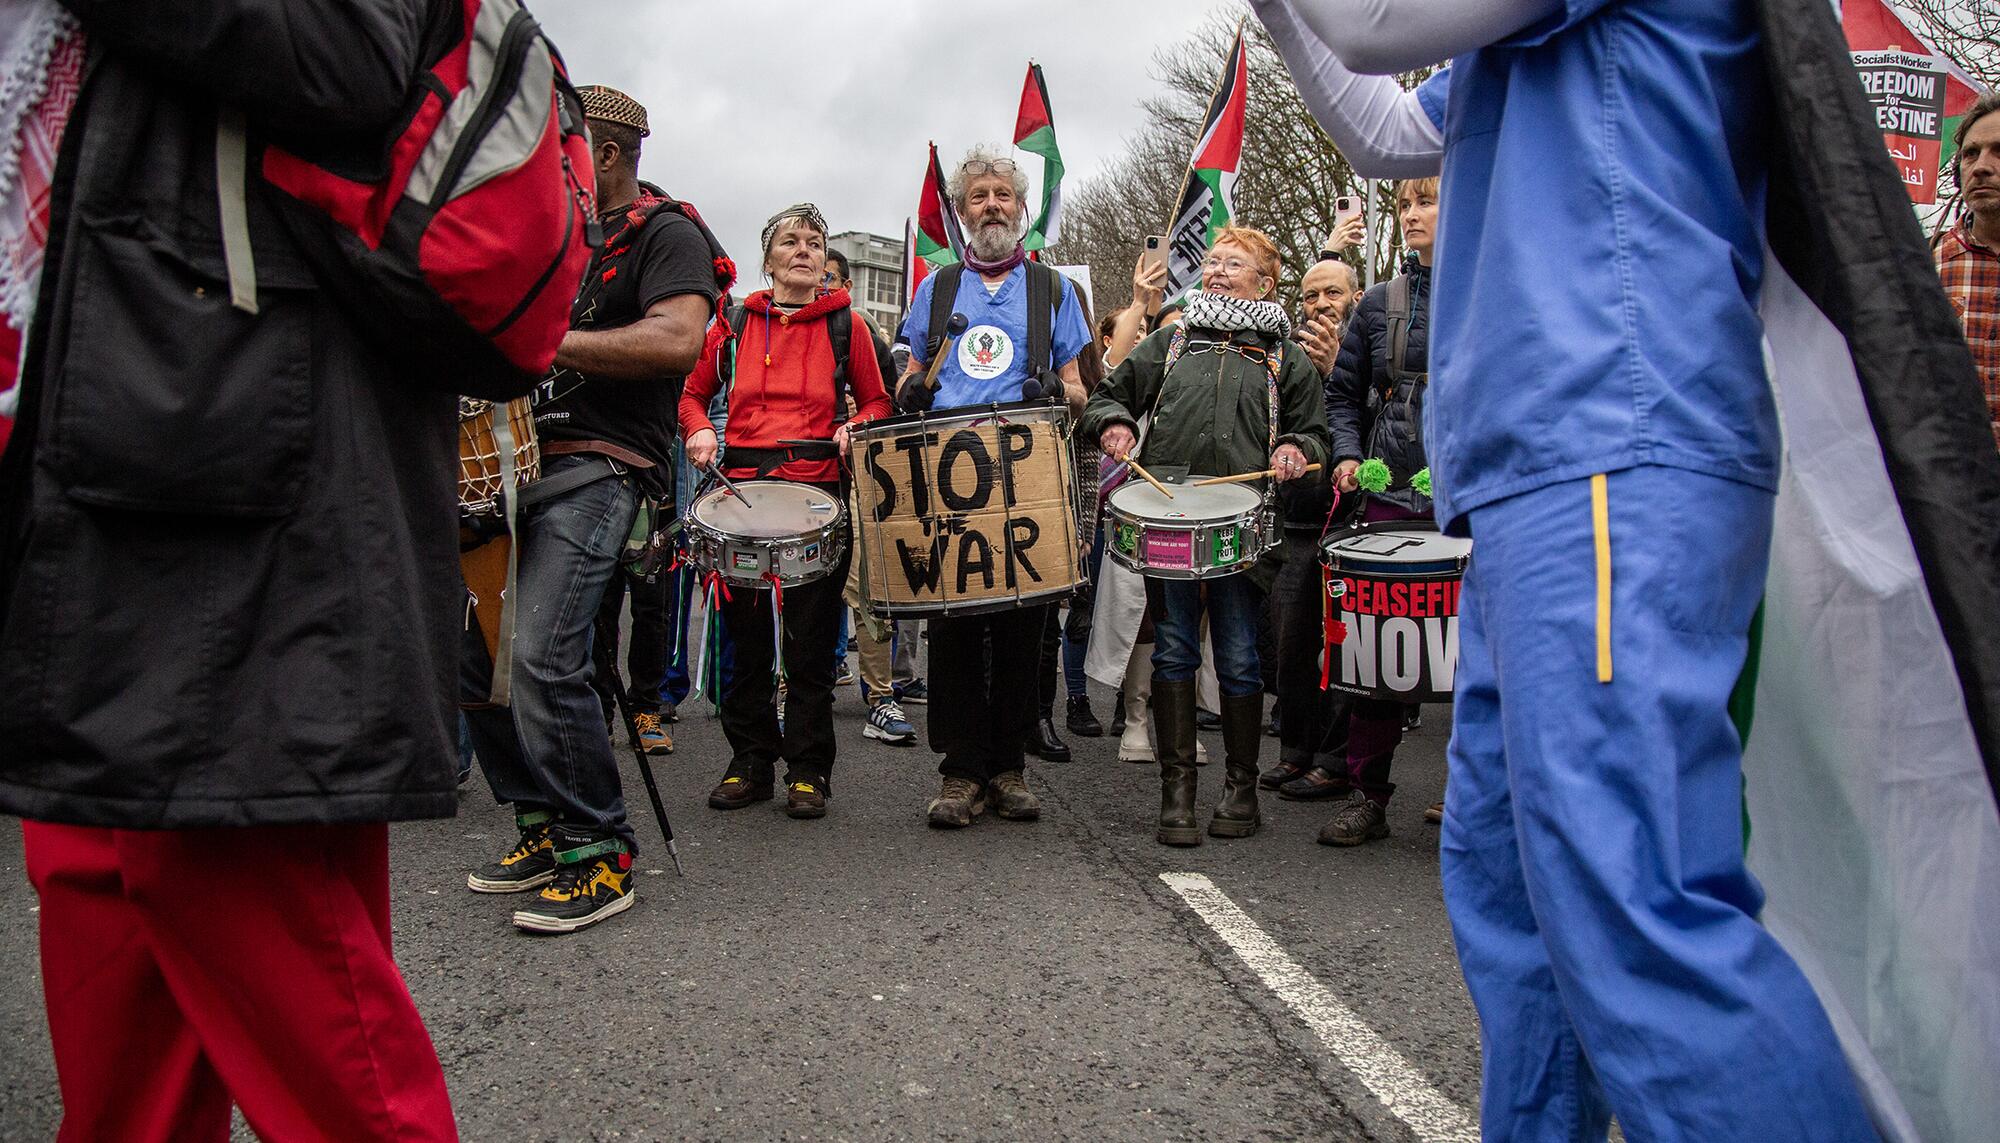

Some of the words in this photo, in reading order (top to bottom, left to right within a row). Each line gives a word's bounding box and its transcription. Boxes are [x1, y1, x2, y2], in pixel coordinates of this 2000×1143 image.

[1859, 71, 1934, 99] REEDOM
[1885, 93, 1900, 105] for
[1876, 105, 1936, 134] ESTINE
[864, 424, 1033, 522] STOP
[919, 514, 970, 537] THE
[896, 517, 1042, 597] WAR
[1220, 538, 1234, 548] FOR
